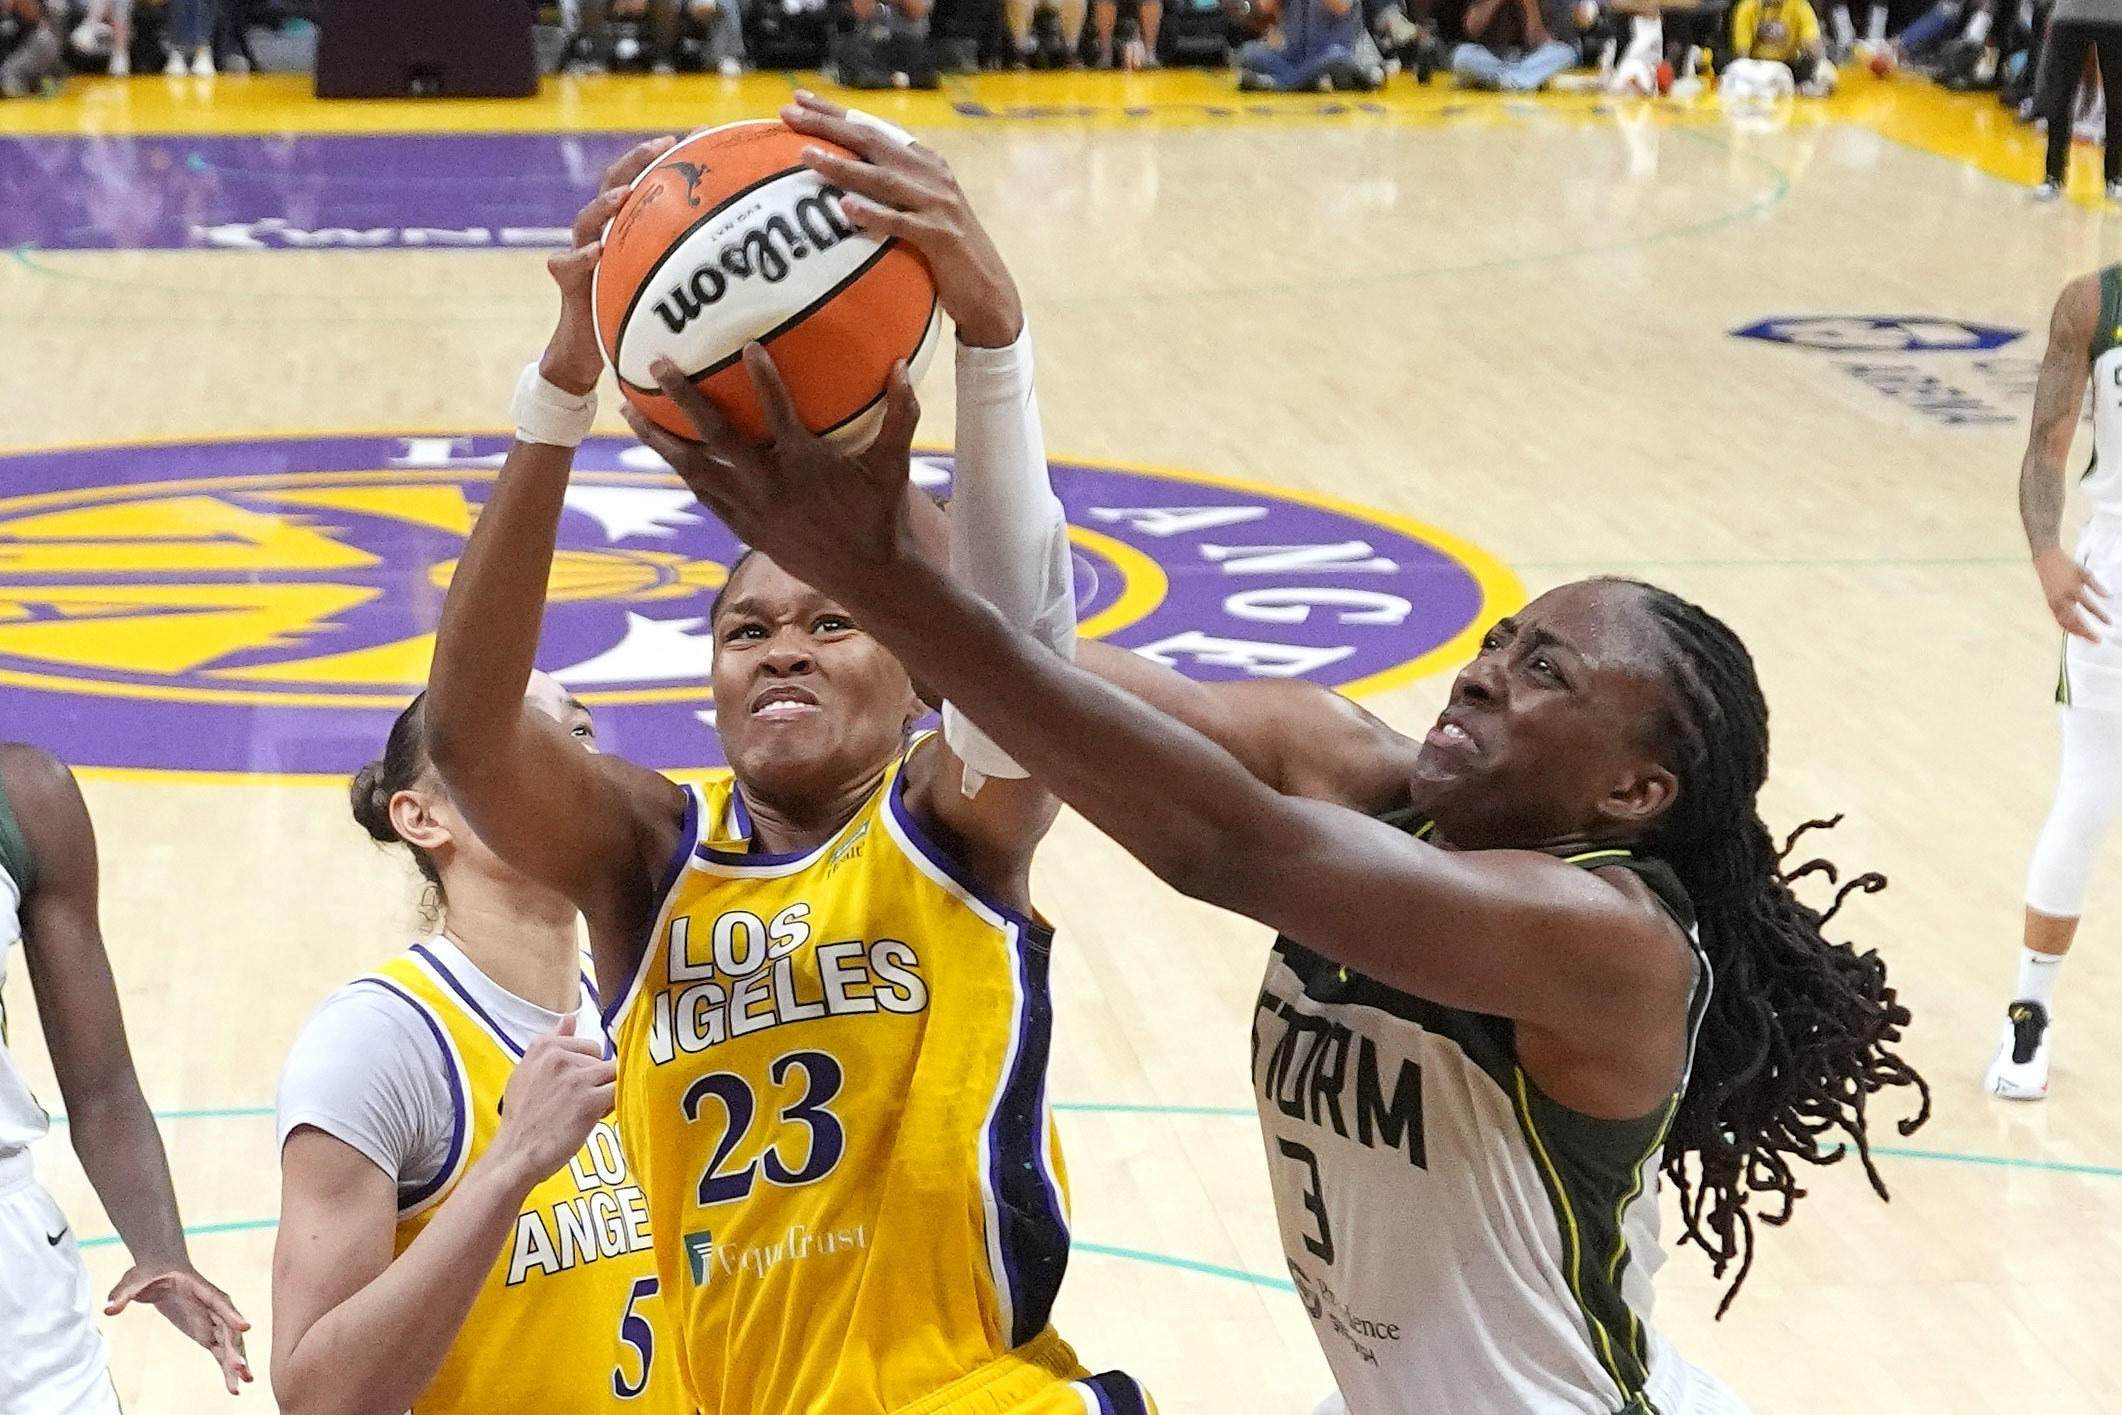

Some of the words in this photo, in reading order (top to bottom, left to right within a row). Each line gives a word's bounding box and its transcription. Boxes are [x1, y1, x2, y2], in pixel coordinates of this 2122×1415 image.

[1088, 506, 1413, 678] ANGE
[649, 938, 929, 1066] NGELES
[669, 902, 811, 984] LOS
[569, 1121, 627, 1192] LO
[681, 1049, 846, 1208] 23
[505, 1185, 654, 1287] ANGE
[1276, 1135, 1334, 1267] 3
[612, 1275, 660, 1400] 5
